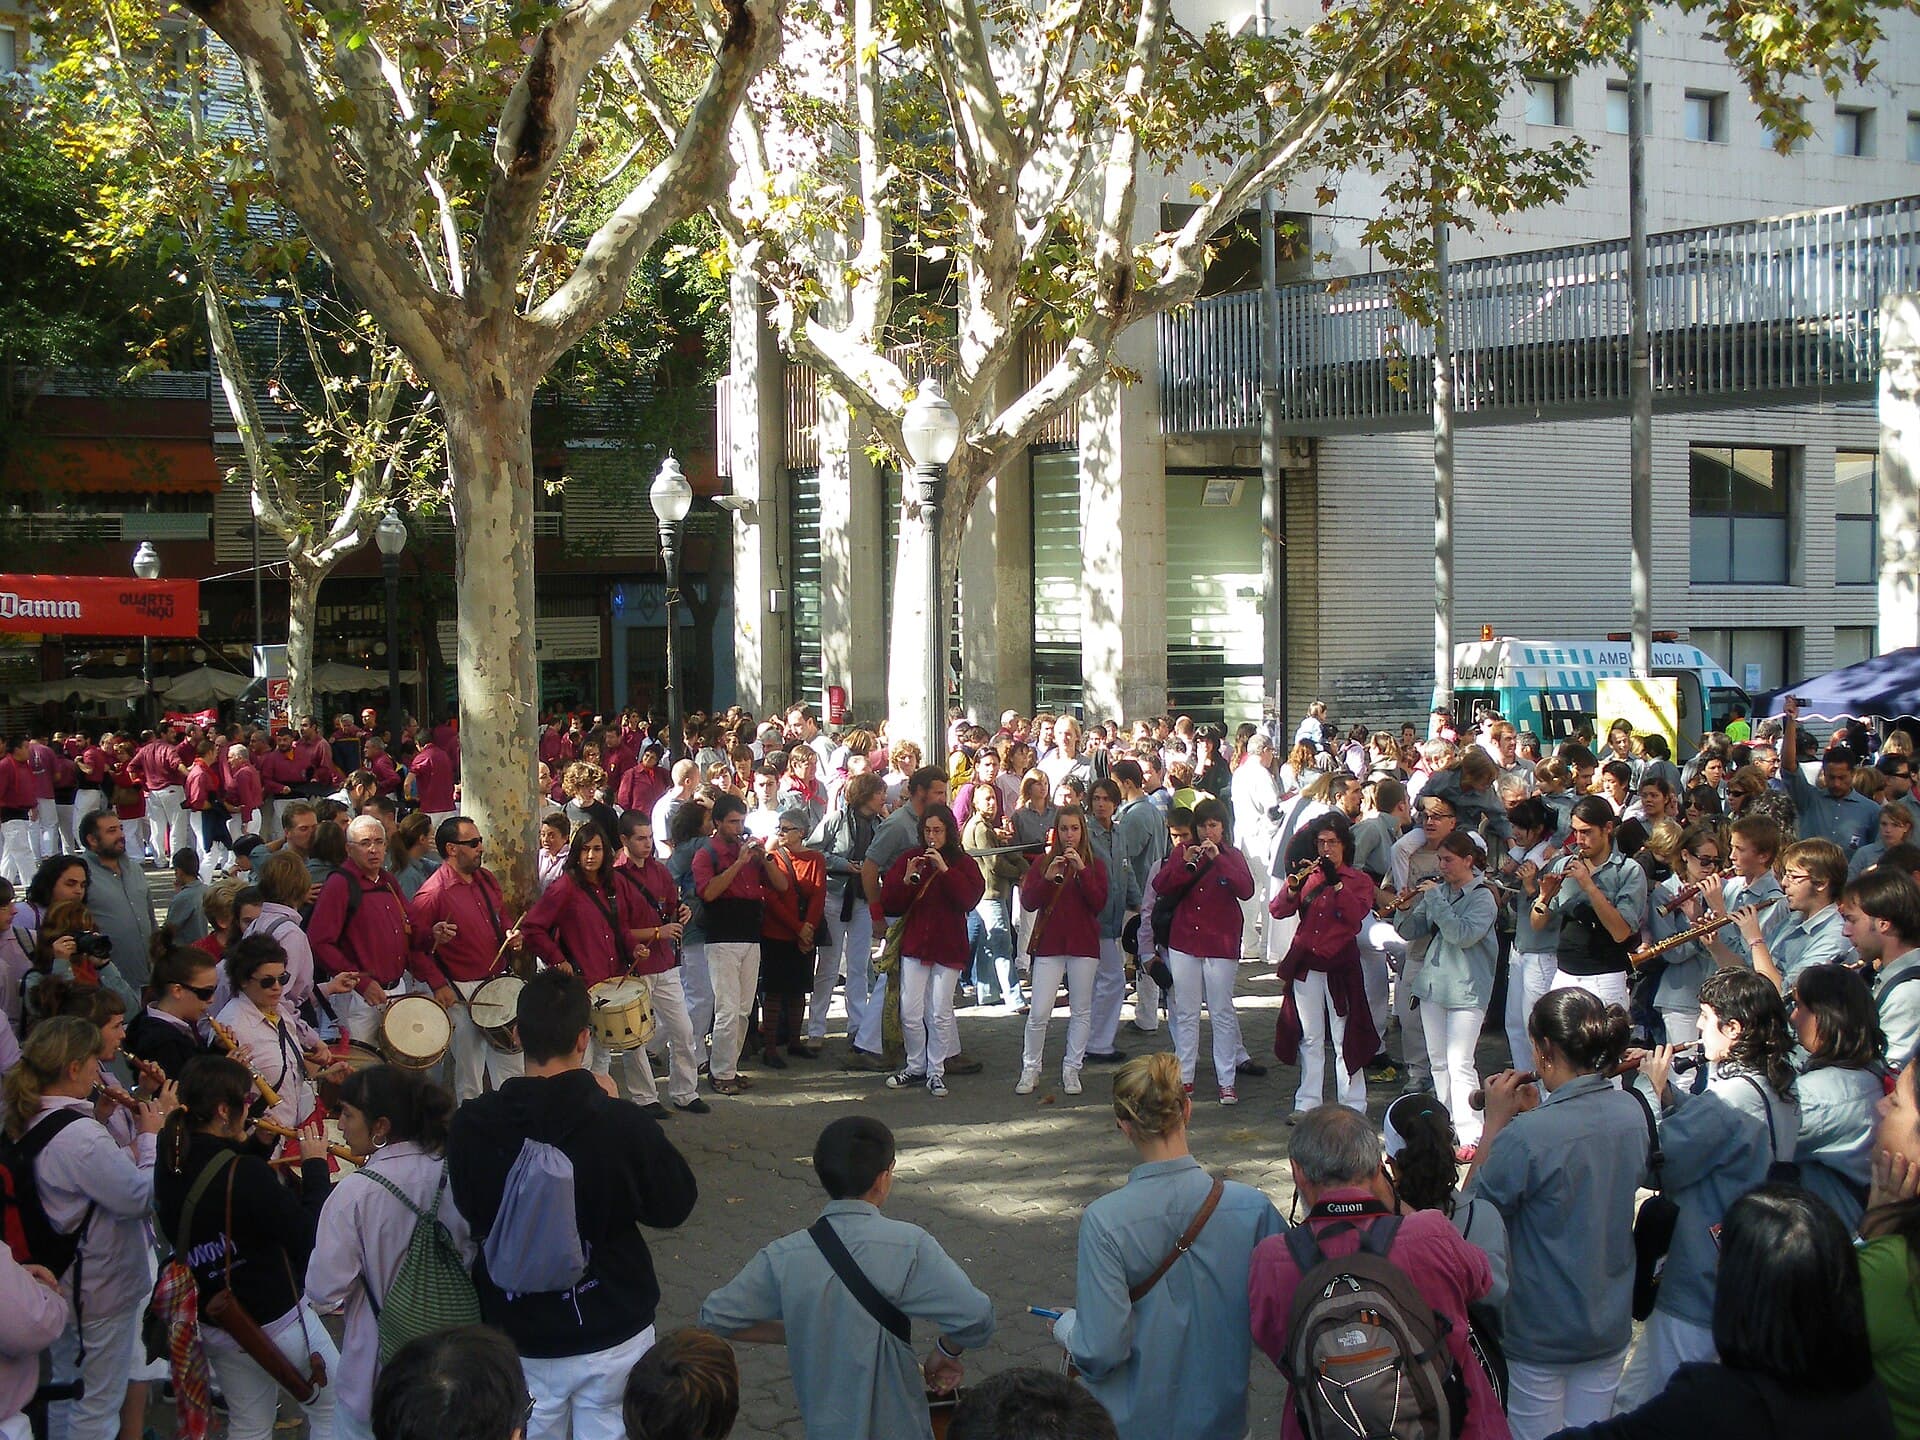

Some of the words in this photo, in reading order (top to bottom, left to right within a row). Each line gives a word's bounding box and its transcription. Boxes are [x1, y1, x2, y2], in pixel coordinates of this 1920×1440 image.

[0, 592, 81, 618] Damm
[1453, 665, 1505, 680] BULANCIA
[1327, 1203, 1362, 1213] Canon
